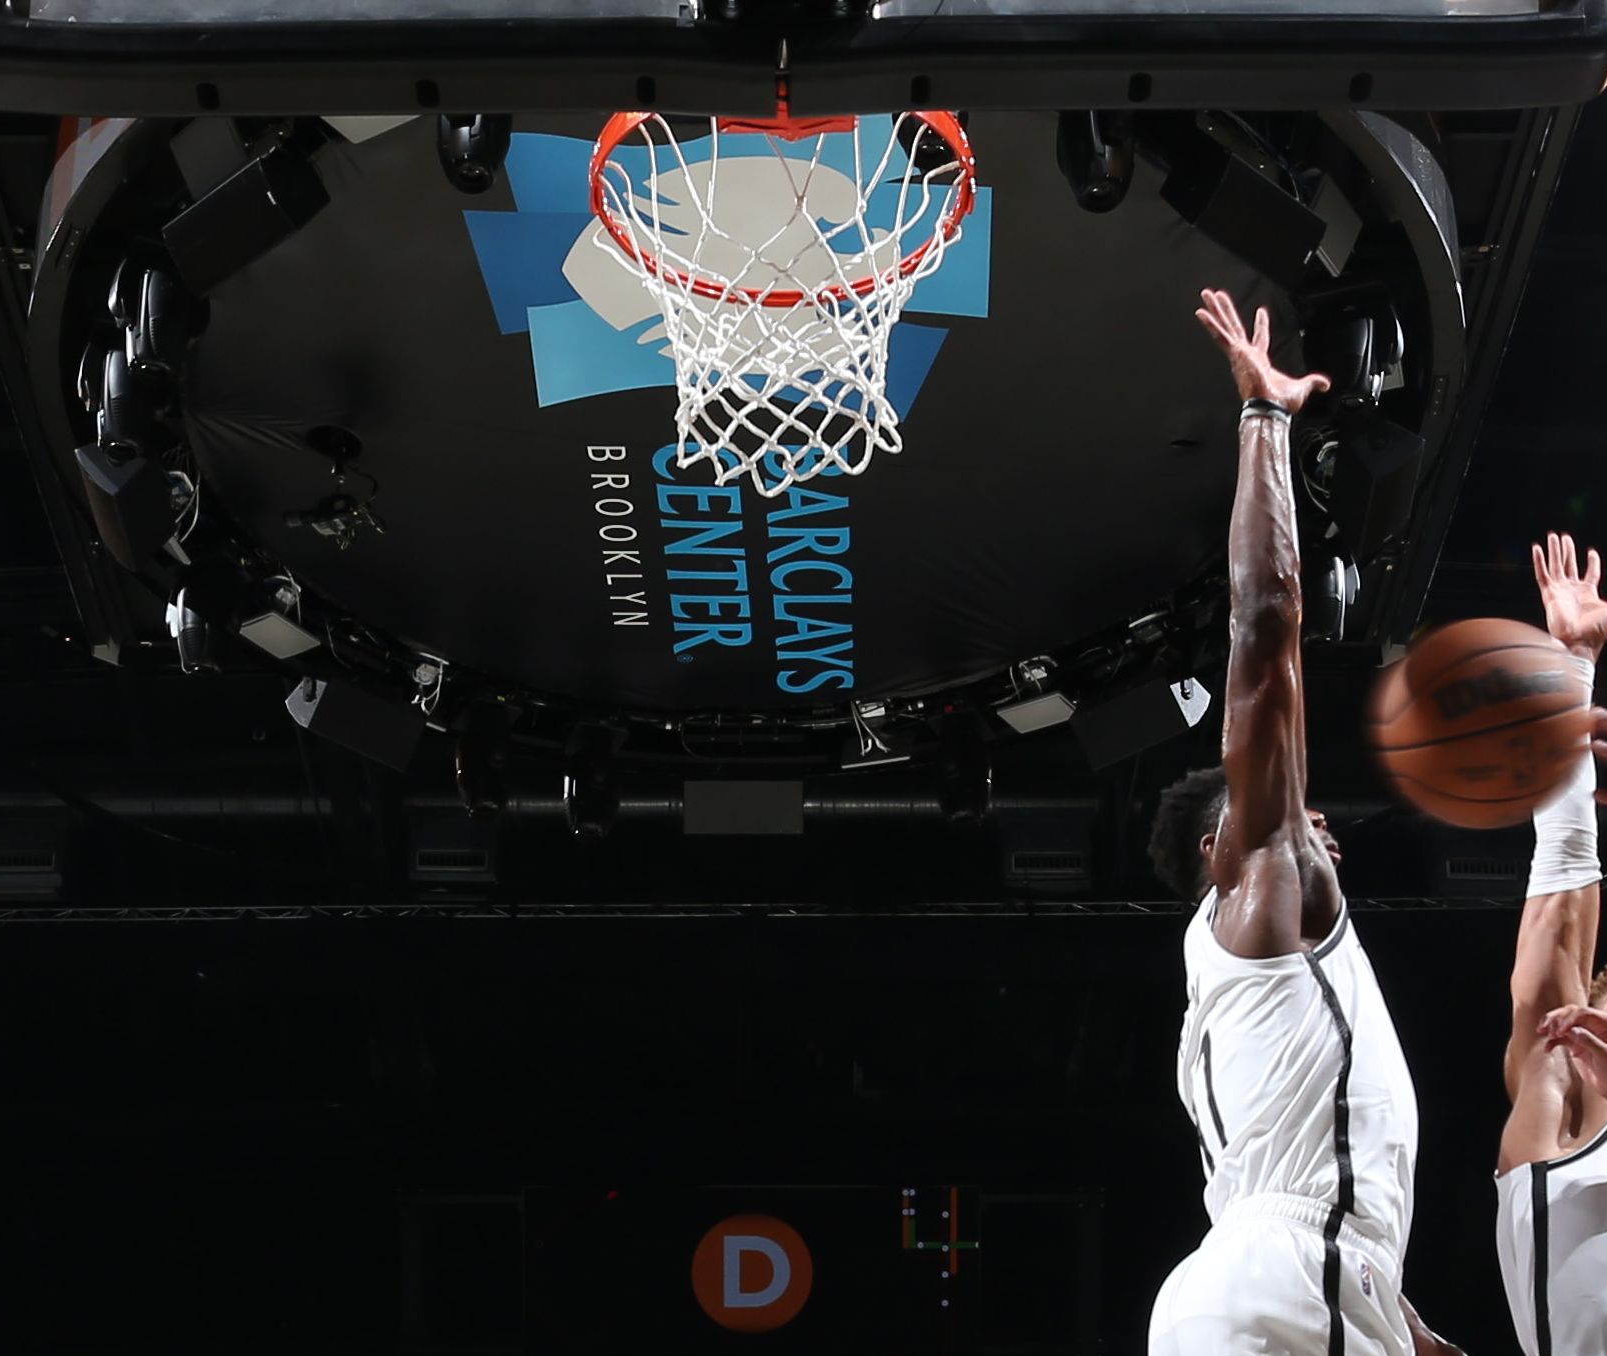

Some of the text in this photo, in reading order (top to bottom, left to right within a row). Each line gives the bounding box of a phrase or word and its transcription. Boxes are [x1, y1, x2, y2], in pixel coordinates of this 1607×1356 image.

[587, 445, 649, 626] BROOKLYN
[652, 442, 753, 655] CENTER
[763, 443, 855, 693] BARCLAYS
[722, 1234, 792, 1308] D
